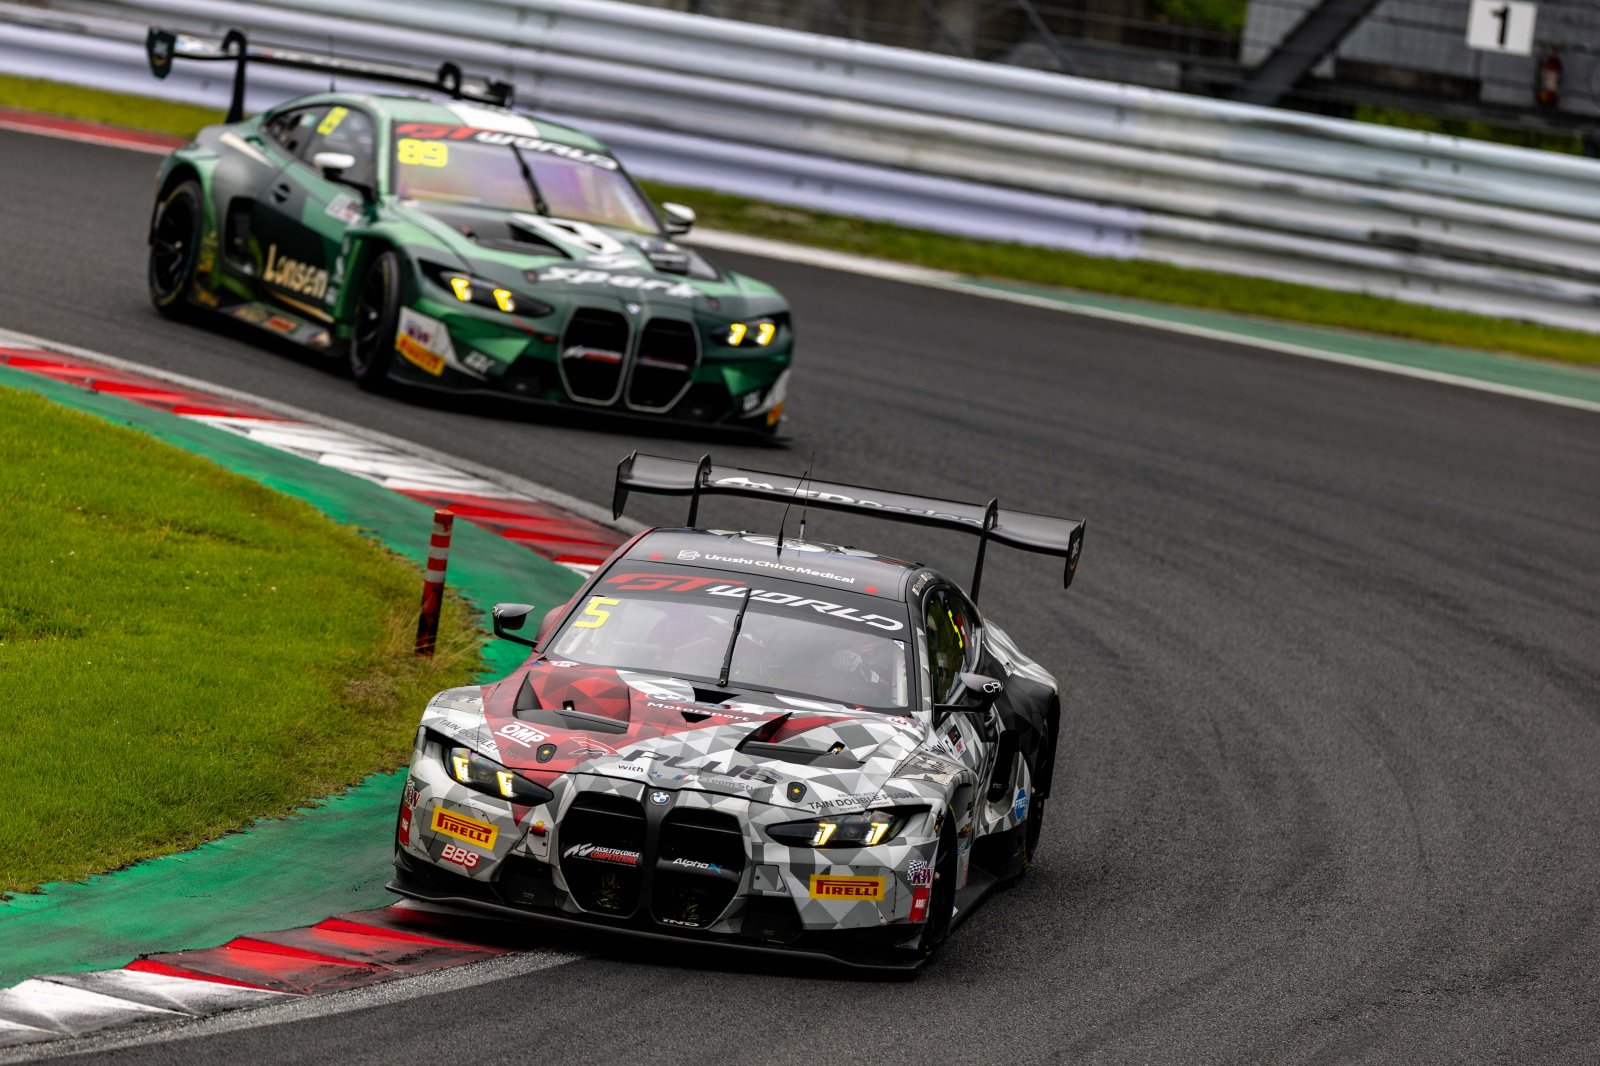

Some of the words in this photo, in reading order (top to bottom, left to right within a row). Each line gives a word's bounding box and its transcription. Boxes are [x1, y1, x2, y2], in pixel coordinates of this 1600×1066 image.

[1490, 6, 1510, 45] 1
[395, 122, 496, 140] GT
[475, 131, 618, 171] WORLD
[397, 137, 448, 169] 89
[704, 553, 752, 565] Urushi
[754, 560, 797, 572] Chiro
[795, 567, 856, 585] Medical
[573, 597, 620, 629] 5
[603, 572, 748, 592] GT
[705, 584, 904, 631] WORLD
[647, 701, 751, 722] Motorsport
[500, 724, 545, 743] OMP
[617, 764, 644, 773] with
[622, 749, 779, 785] PLUS
[808, 801, 834, 811] TAIN
[836, 794, 881, 807] DOUBLE
[436, 812, 493, 844] PIRELLI
[441, 843, 480, 869] BBS
[589, 852, 638, 865] COMPETIZIONE
[593, 846, 621, 855] ASSETTO
[620, 848, 640, 858] CORSA
[815, 879, 880, 897] PIRELLI
